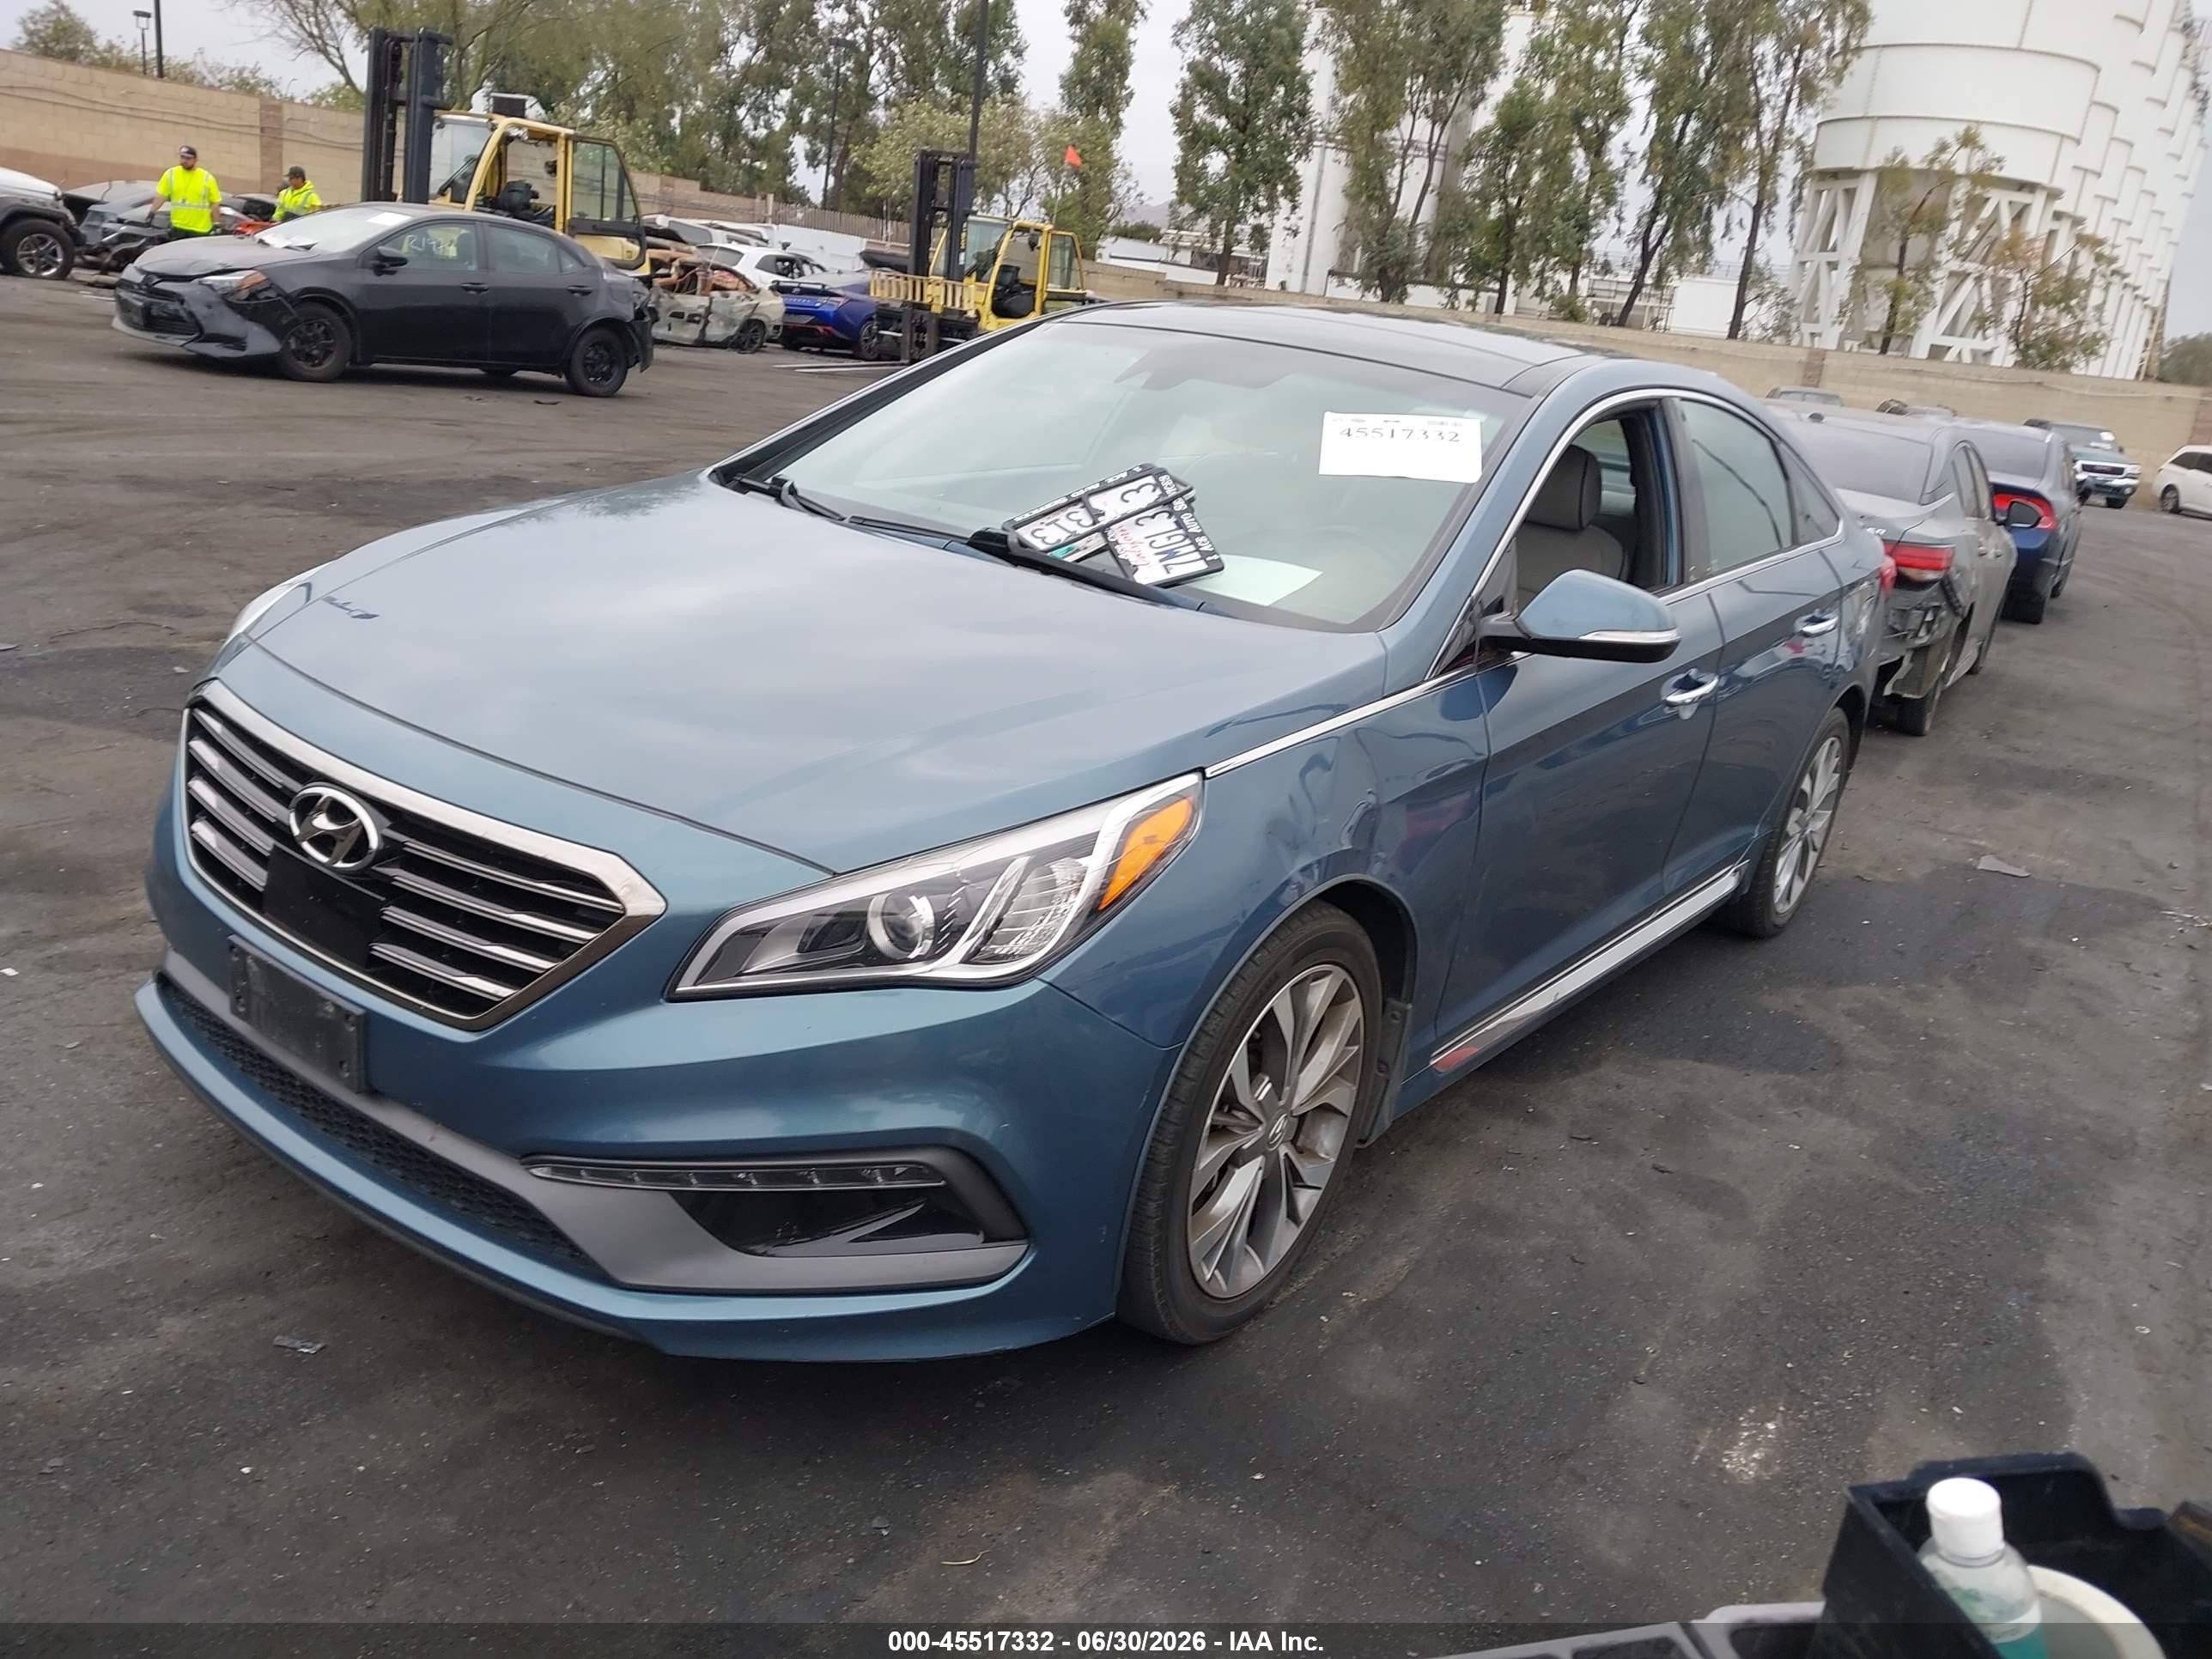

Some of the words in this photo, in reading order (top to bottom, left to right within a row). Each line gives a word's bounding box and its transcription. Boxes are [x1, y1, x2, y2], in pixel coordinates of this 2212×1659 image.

[1339, 426, 1461, 443] 45517332
[1180, 512, 1203, 532] AUTO
[1194, 536, 1215, 551] ACE
